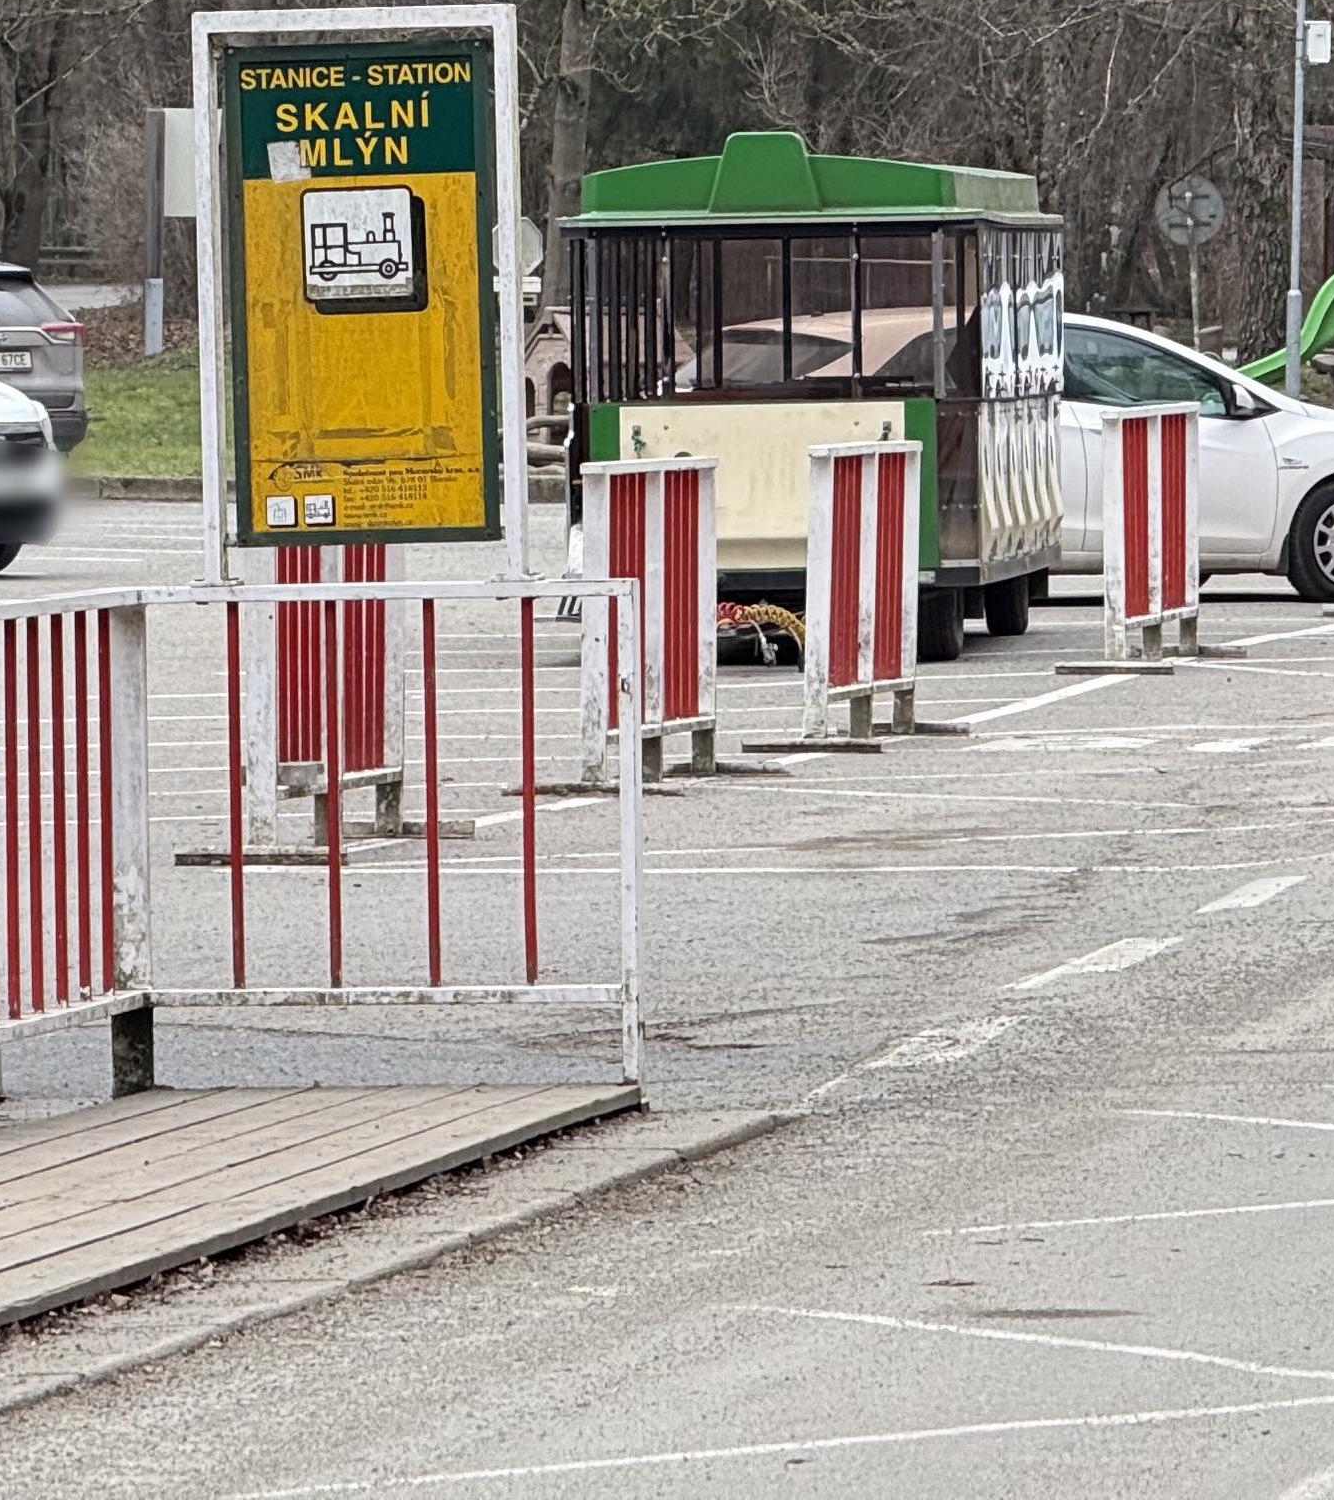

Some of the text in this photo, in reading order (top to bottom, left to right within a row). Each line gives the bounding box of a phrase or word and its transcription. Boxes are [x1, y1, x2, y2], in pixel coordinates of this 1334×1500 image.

[240, 66, 346, 90] STANICE
[367, 62, 471, 86] STATION
[276, 91, 429, 132] SKALNÍ
[299, 131, 408, 167] MLÝN
